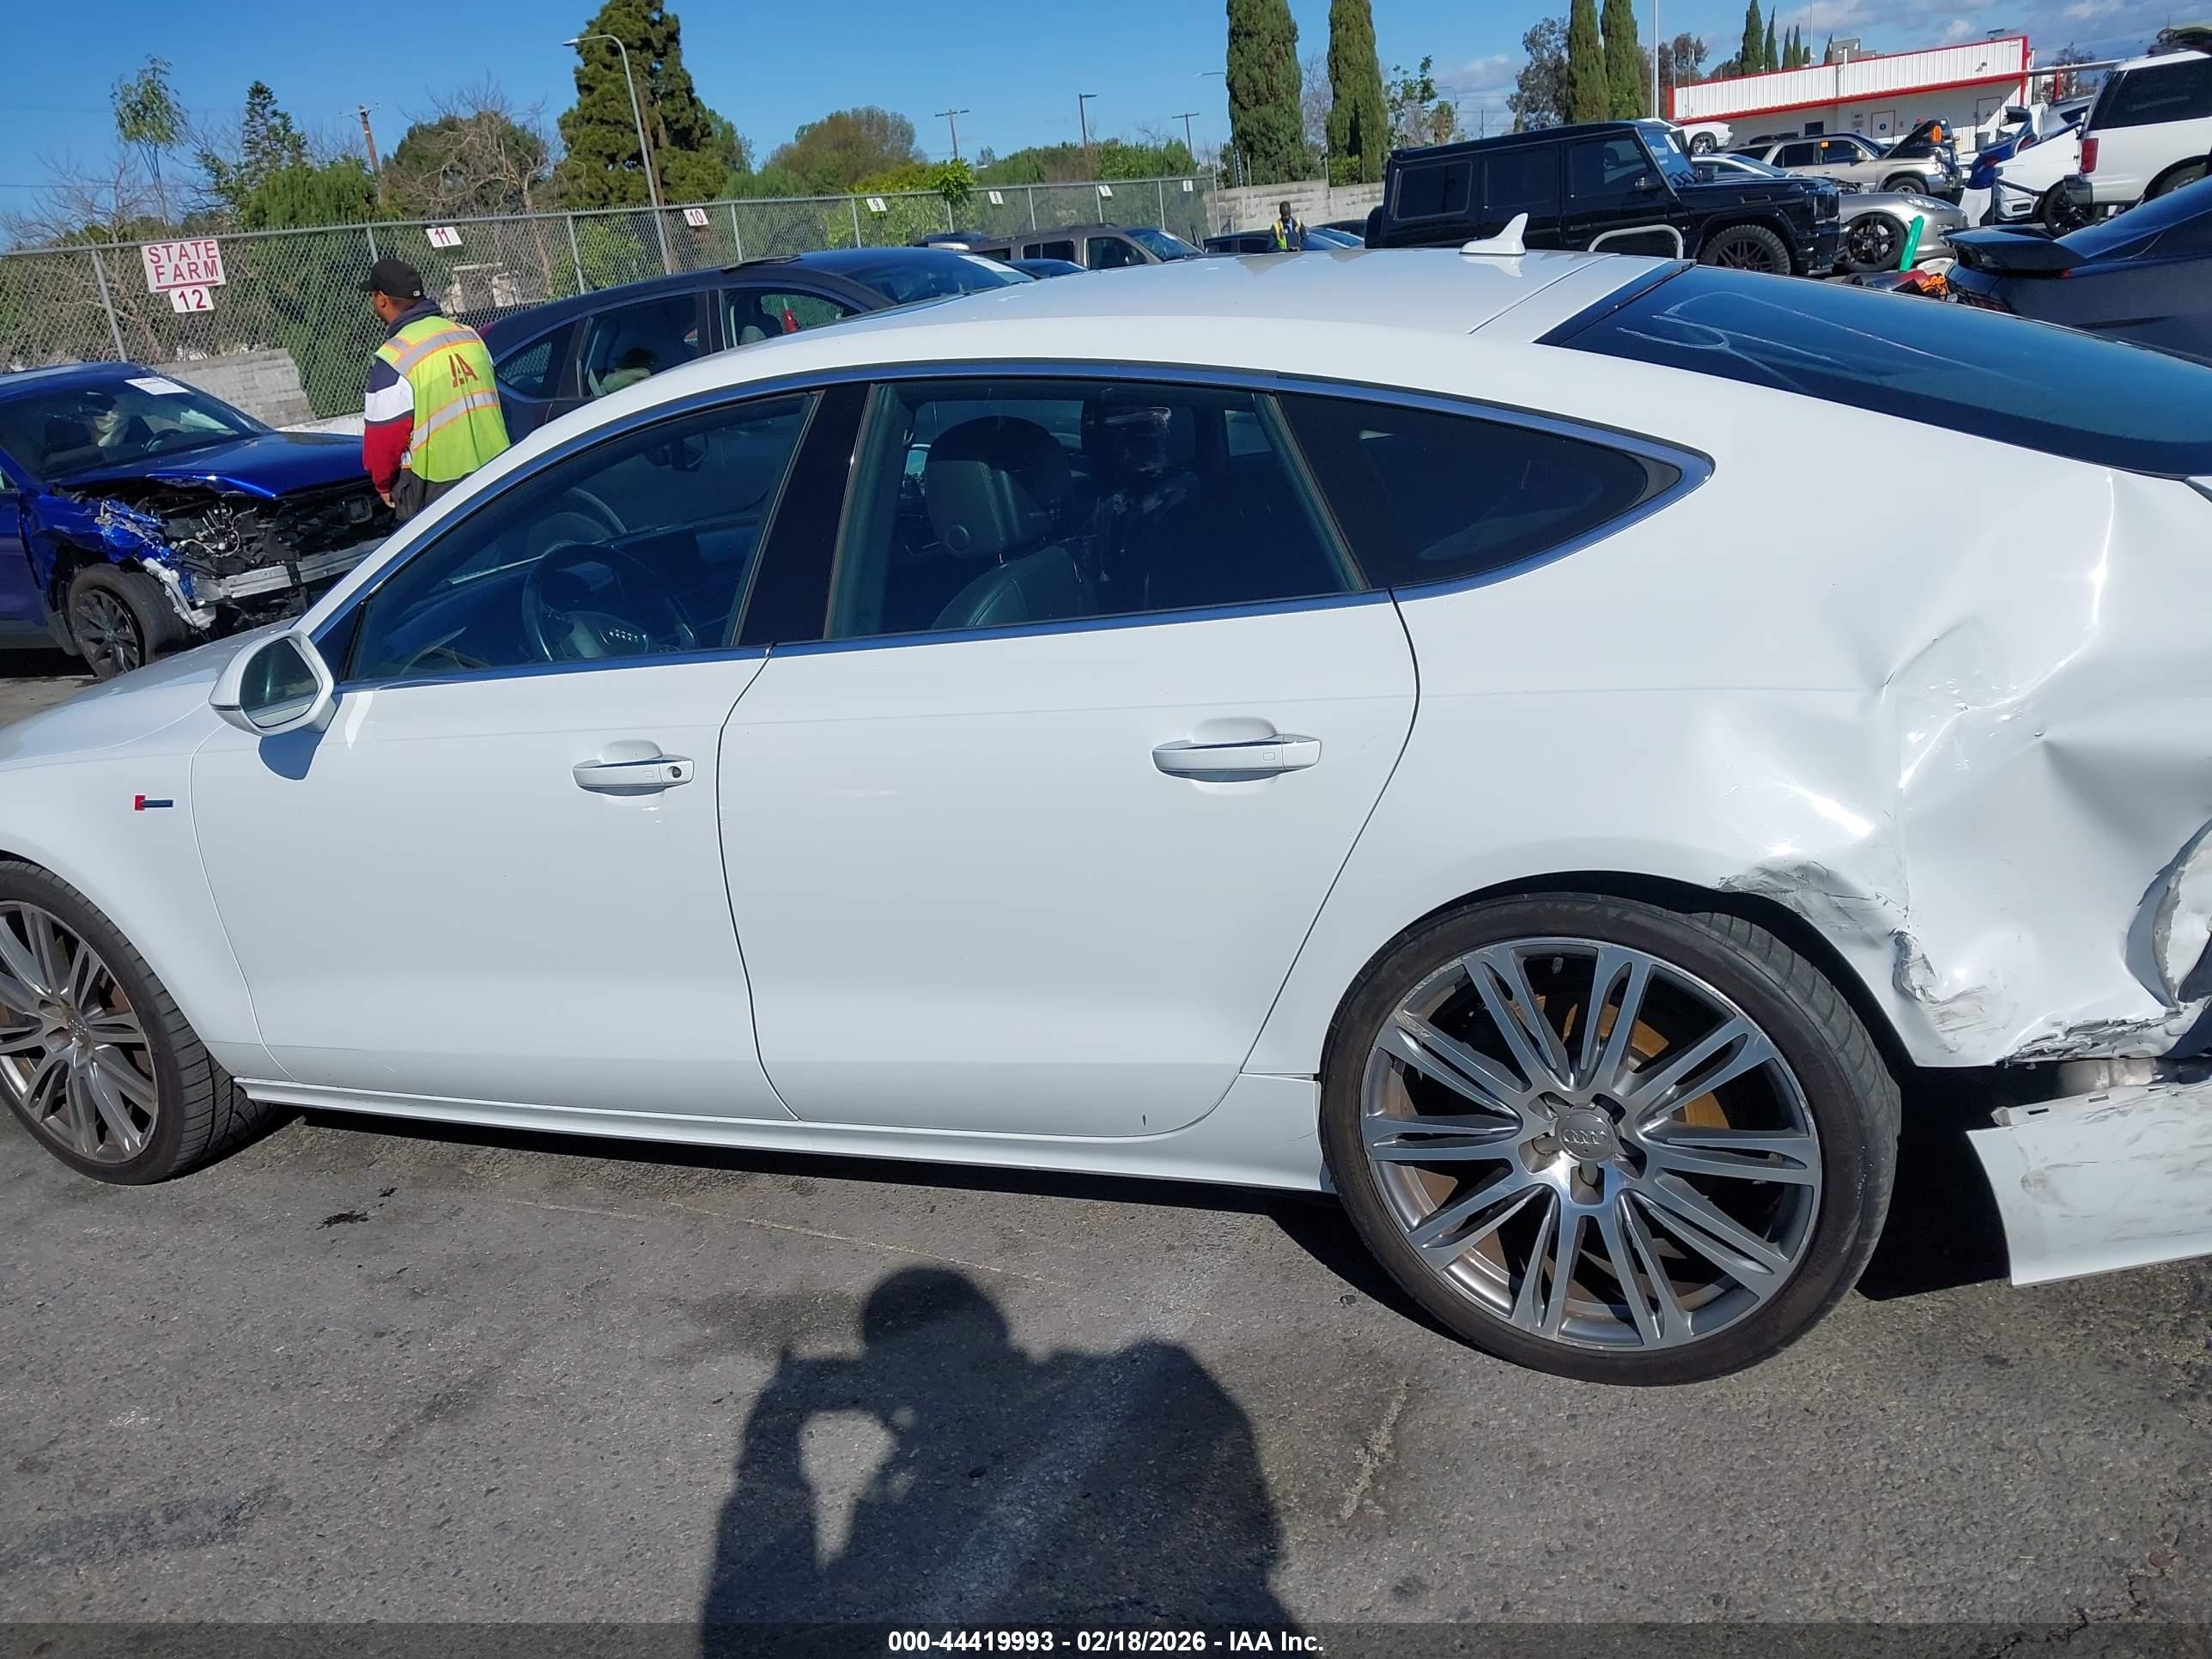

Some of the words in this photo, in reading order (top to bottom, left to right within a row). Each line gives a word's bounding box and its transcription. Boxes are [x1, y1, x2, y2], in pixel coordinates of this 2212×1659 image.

[872, 198, 881, 210] 9
[690, 210, 704, 224] 10
[434, 228, 451, 245] 11
[148, 240, 217, 264] STATE
[155, 259, 219, 283] FARM
[178, 289, 207, 311] 12
